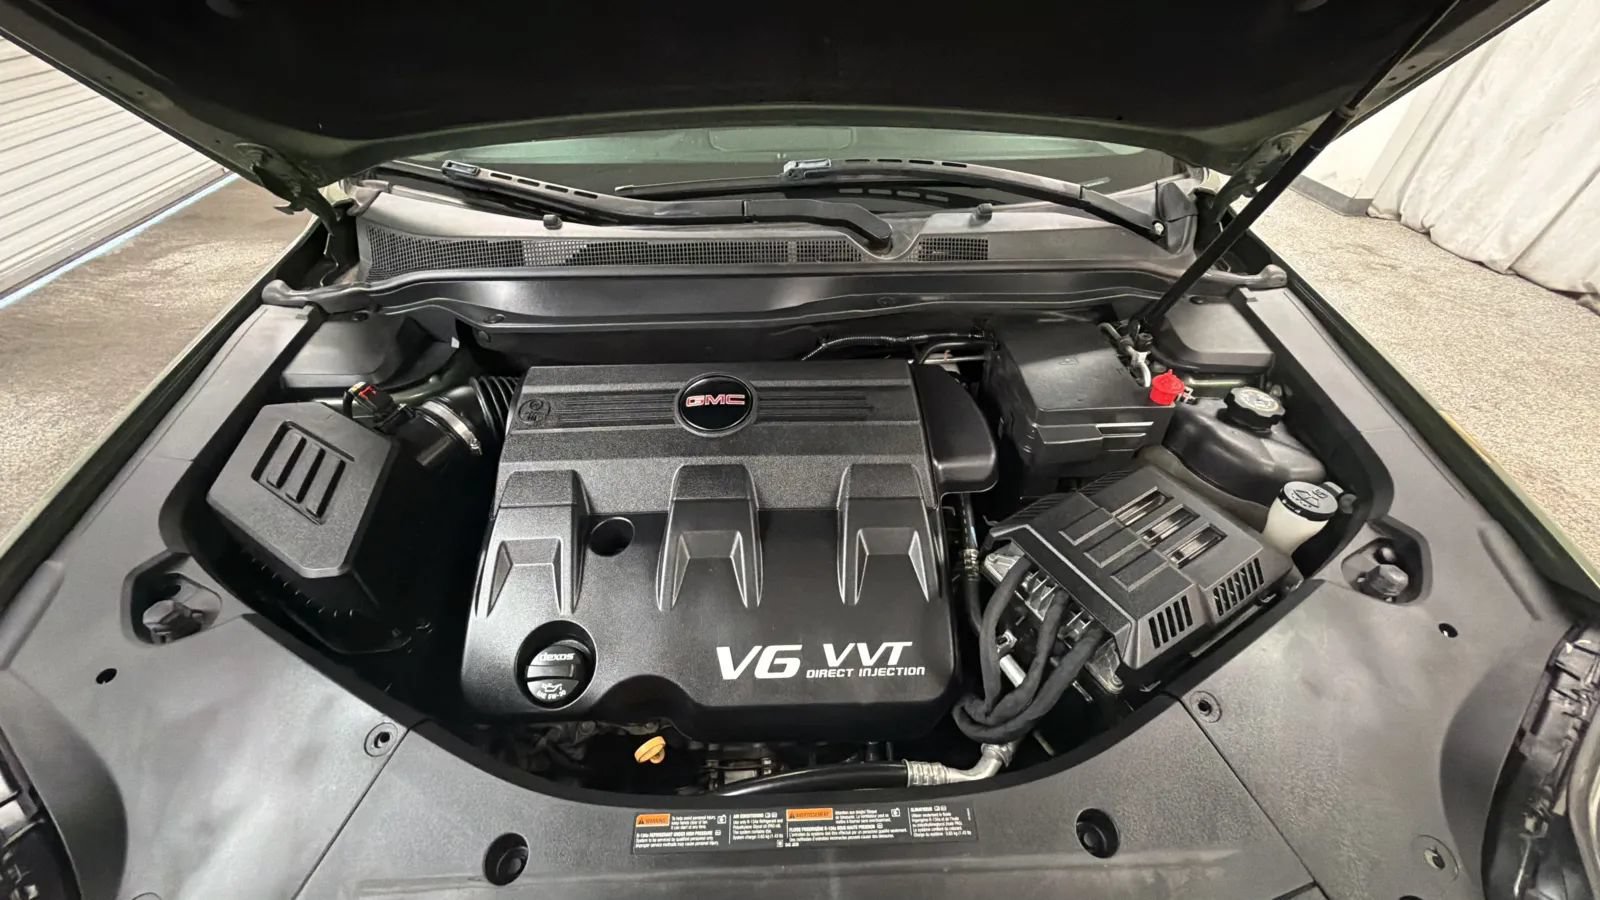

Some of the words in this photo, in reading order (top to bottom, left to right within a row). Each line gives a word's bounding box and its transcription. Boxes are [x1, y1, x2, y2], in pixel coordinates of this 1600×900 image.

[686, 394, 745, 407] GMC
[539, 651, 576, 661] dexos
[716, 644, 803, 680] V6
[823, 641, 913, 667] VVT
[806, 668, 854, 678] DIRECT
[859, 666, 926, 677] INJECTION
